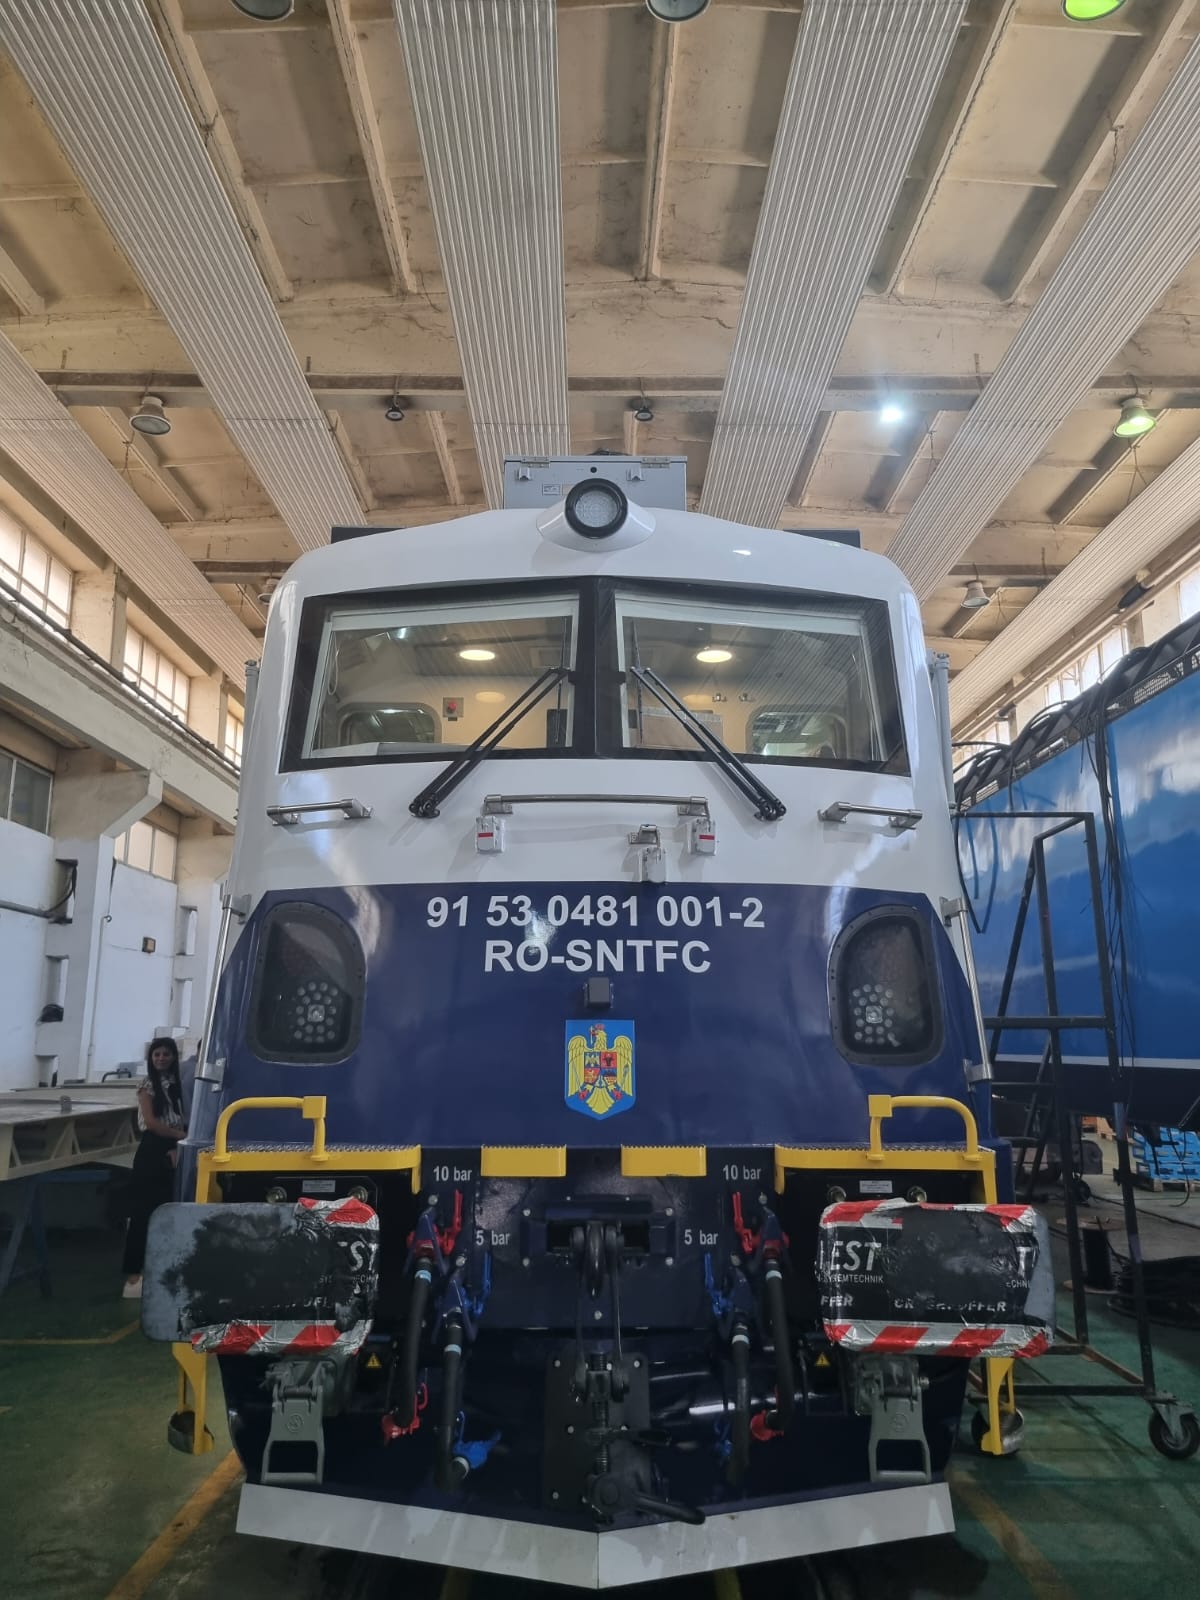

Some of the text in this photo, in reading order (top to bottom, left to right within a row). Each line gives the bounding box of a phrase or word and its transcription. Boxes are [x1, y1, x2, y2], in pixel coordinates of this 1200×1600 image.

[426, 895, 765, 928] 91 53 0481 001-2
[484, 939, 711, 973] RO-SNTFC
[433, 1165, 472, 1181] 10 bar
[722, 1165, 761, 1180] 10 bar
[475, 1229, 510, 1246] 5 bar
[684, 1229, 718, 1245] 5 bar
